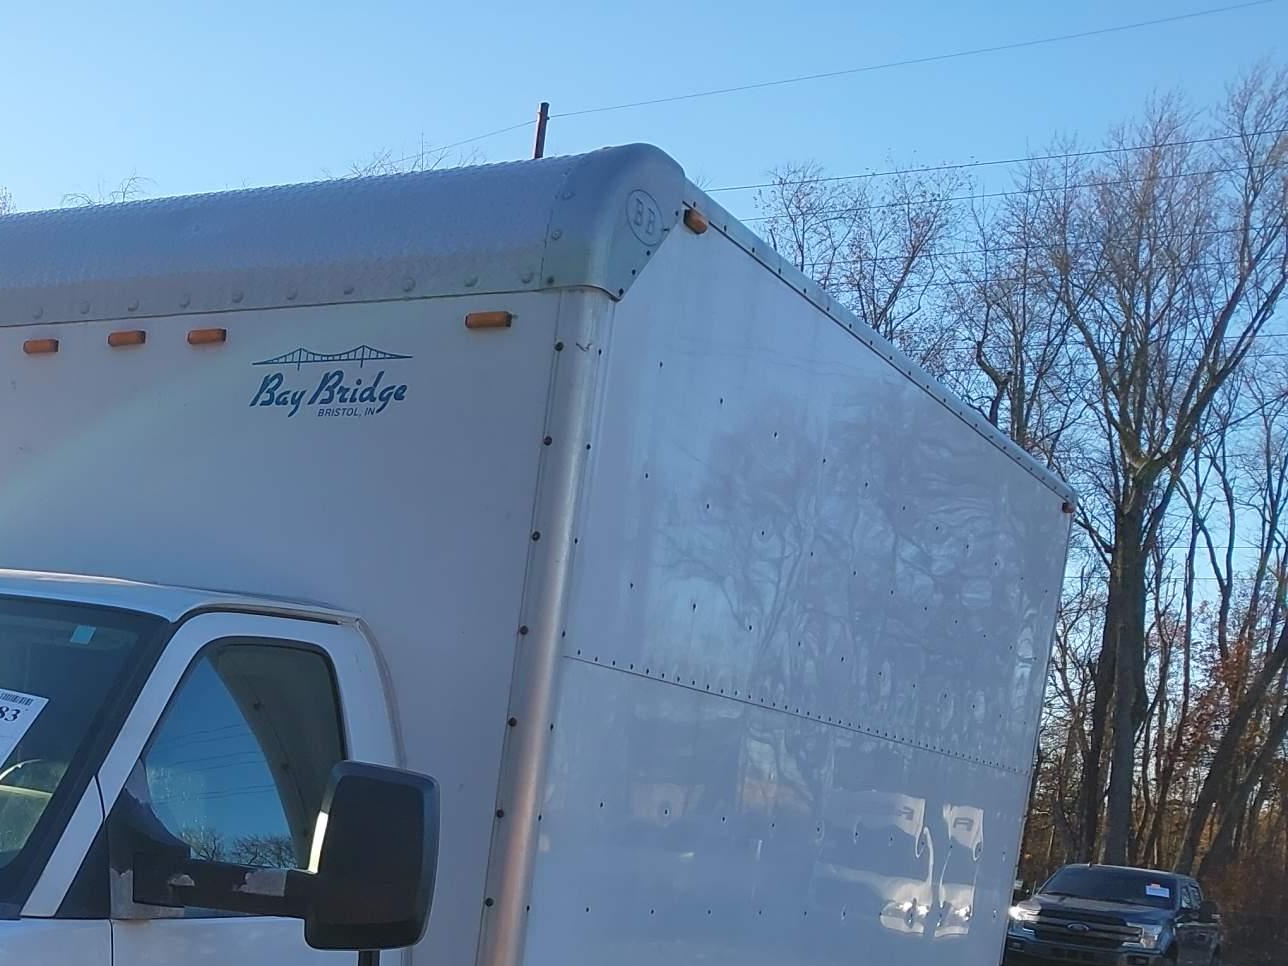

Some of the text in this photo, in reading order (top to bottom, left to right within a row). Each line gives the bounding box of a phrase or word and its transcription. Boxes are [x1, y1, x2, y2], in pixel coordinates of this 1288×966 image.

[249, 370, 408, 418] Bay Bridge
[317, 408, 376, 417] BRISTOL, IN
